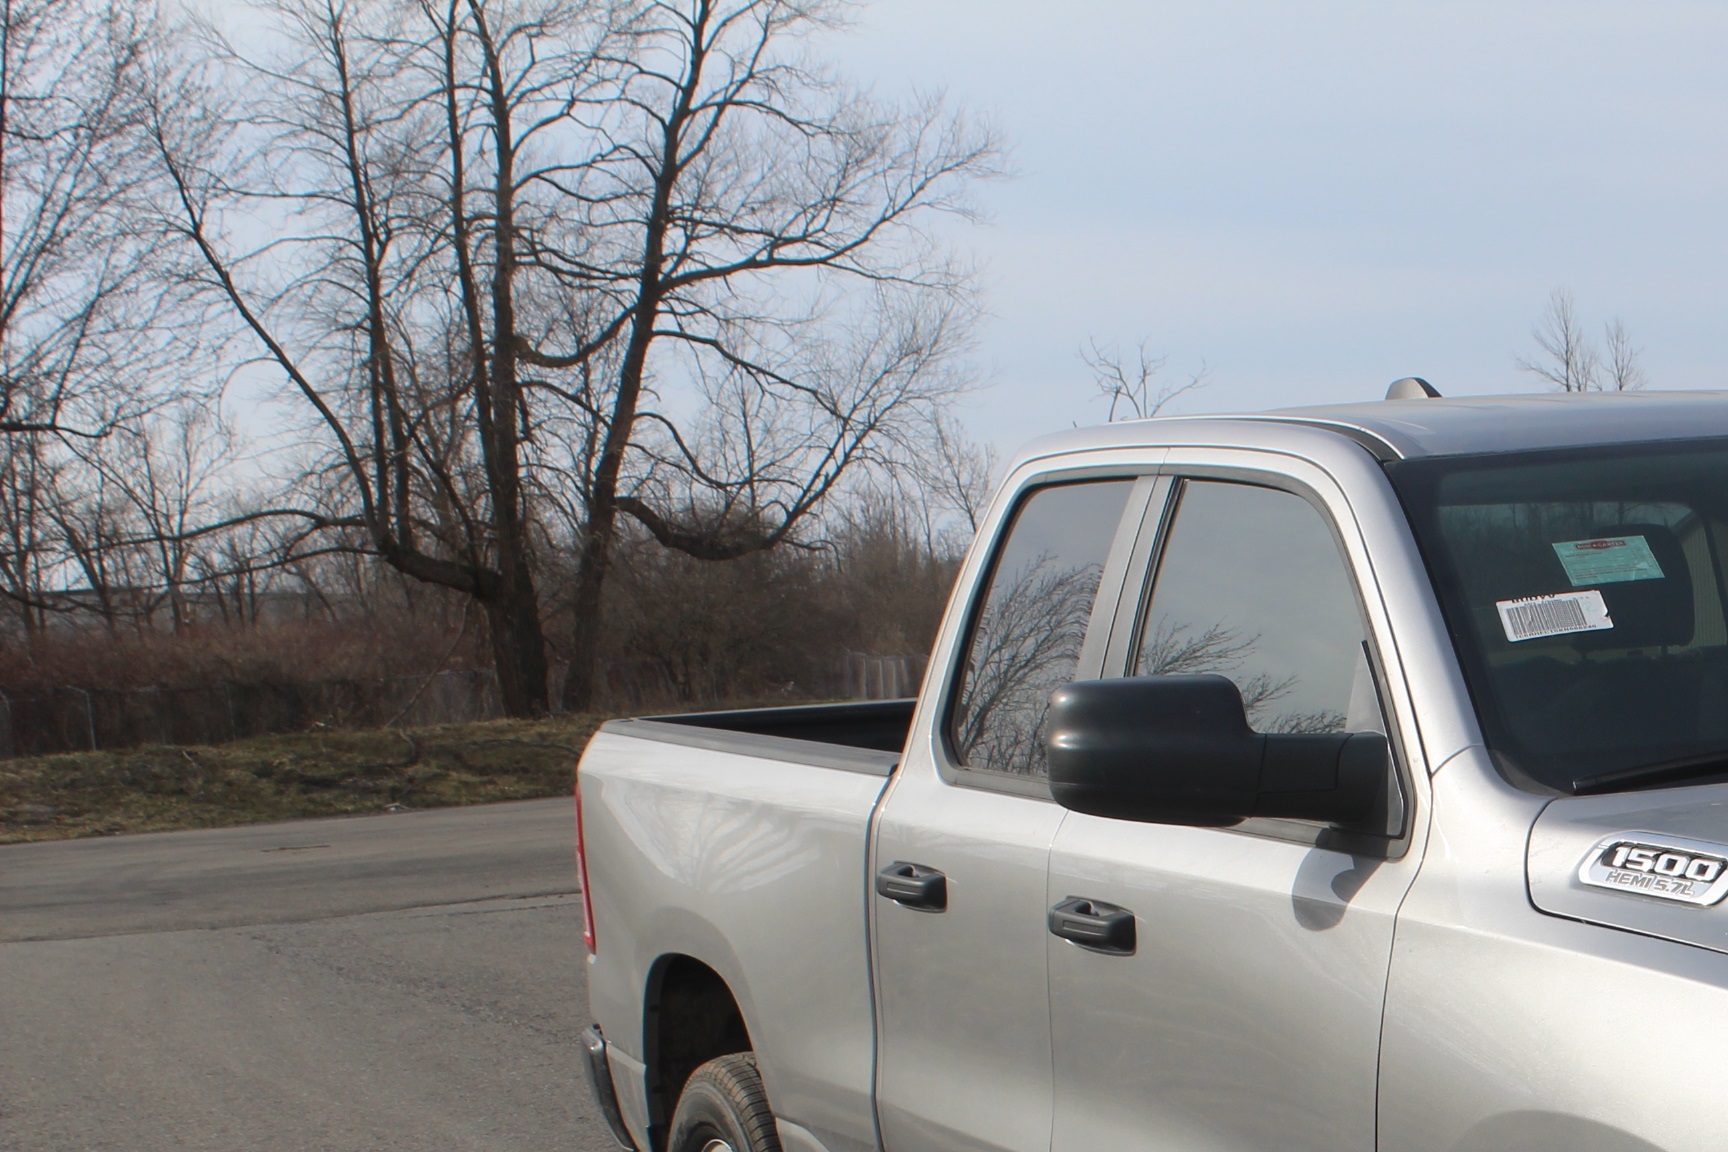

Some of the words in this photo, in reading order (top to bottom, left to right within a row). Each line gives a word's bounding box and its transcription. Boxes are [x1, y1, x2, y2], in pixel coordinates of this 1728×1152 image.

[1611, 846, 1724, 882] 1500
[1604, 869, 1652, 889] HEMI
[1653, 877, 1696, 896] 5.7L
